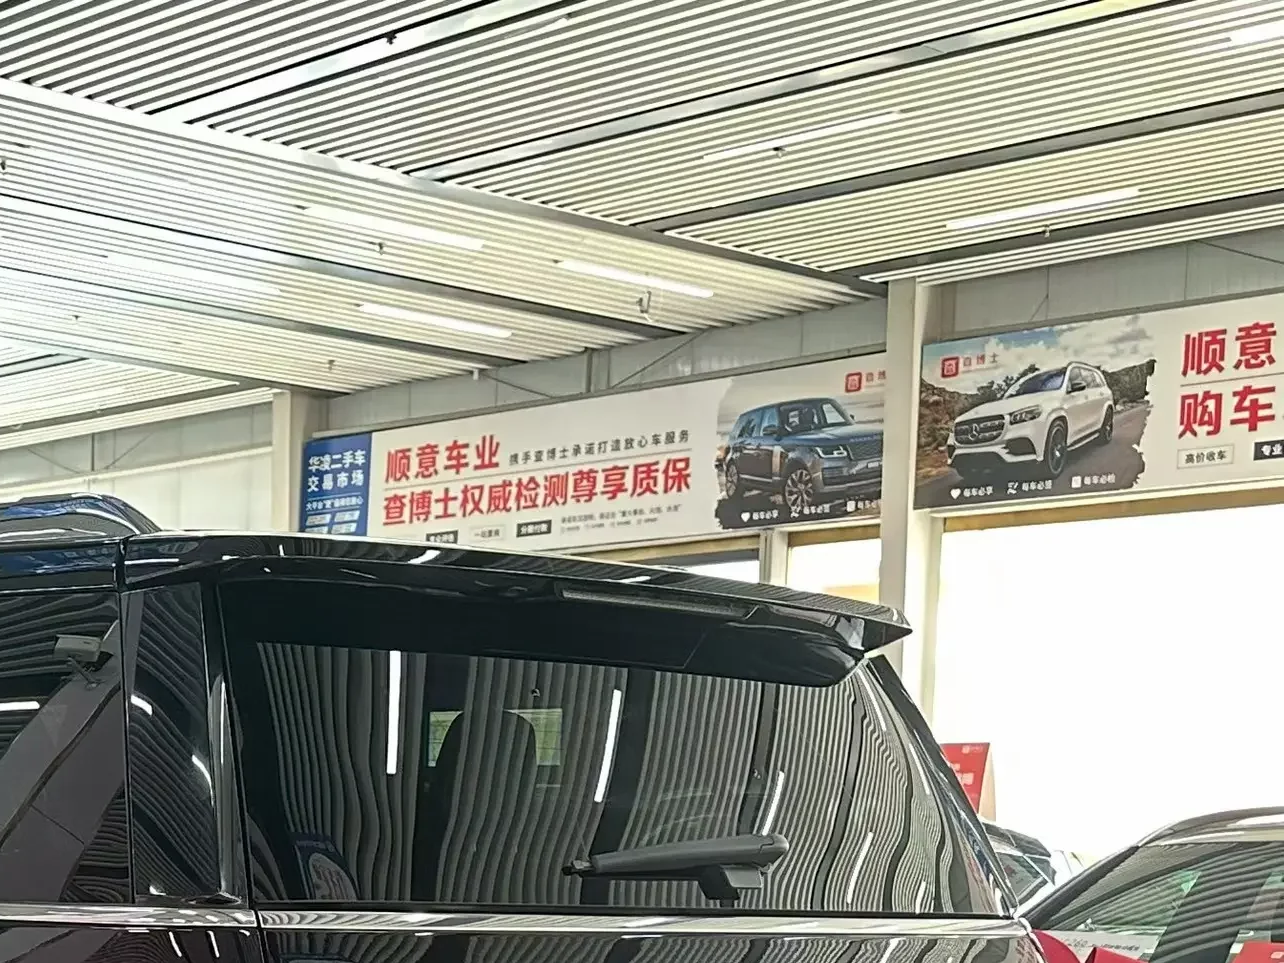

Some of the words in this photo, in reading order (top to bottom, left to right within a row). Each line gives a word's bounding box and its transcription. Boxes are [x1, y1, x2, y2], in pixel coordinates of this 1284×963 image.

[1181, 322, 1277, 378] 顺意
[1177, 385, 1276, 440] 购车
[307, 470, 365, 493] 交易市场
[308, 449, 366, 473] 华凌二手车
[384, 434, 501, 484] 顺意车业
[1184, 449, 1227, 464] 高价收车
[382, 456, 692, 527] 查博士权威检测尊享质保
